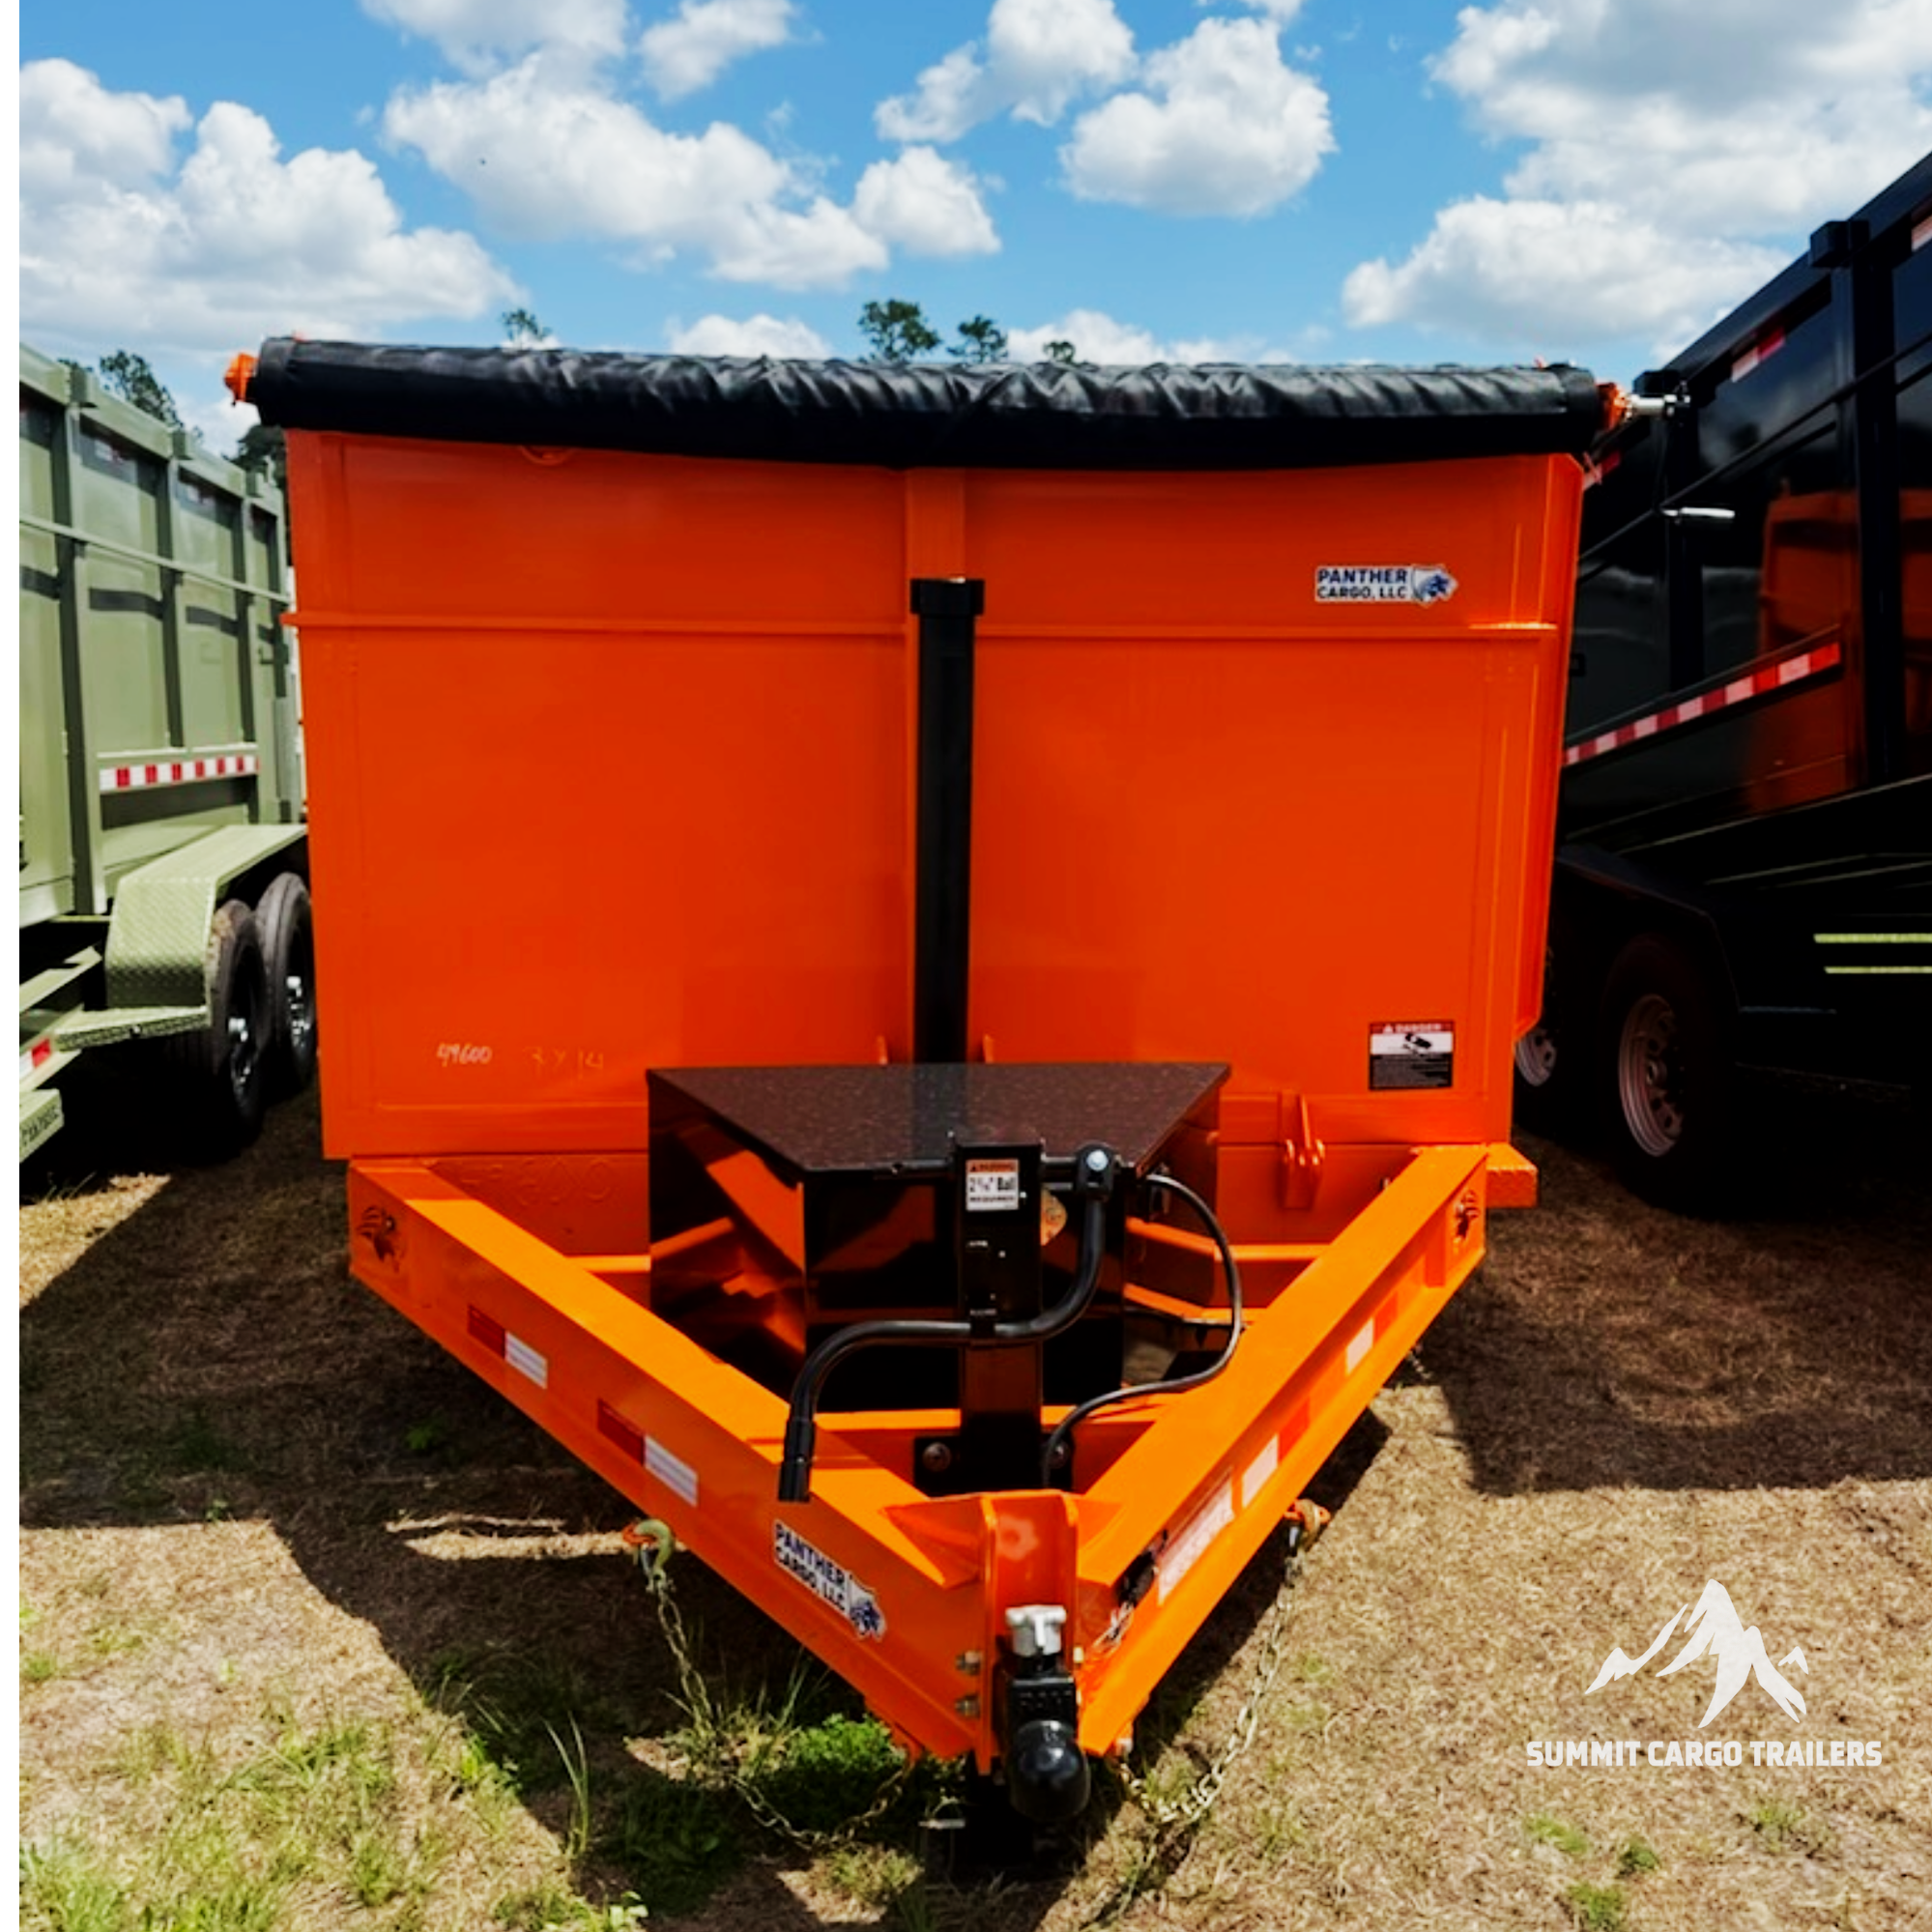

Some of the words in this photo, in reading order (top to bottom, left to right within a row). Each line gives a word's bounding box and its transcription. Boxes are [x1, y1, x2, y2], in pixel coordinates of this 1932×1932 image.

[1317, 568, 1407, 583] PANTHER
[1316, 586, 1375, 599] CARGO,
[1379, 586, 1407, 598] LLC
[775, 1523, 845, 1591] PANTHER
[822, 1581, 846, 1611] LLC
